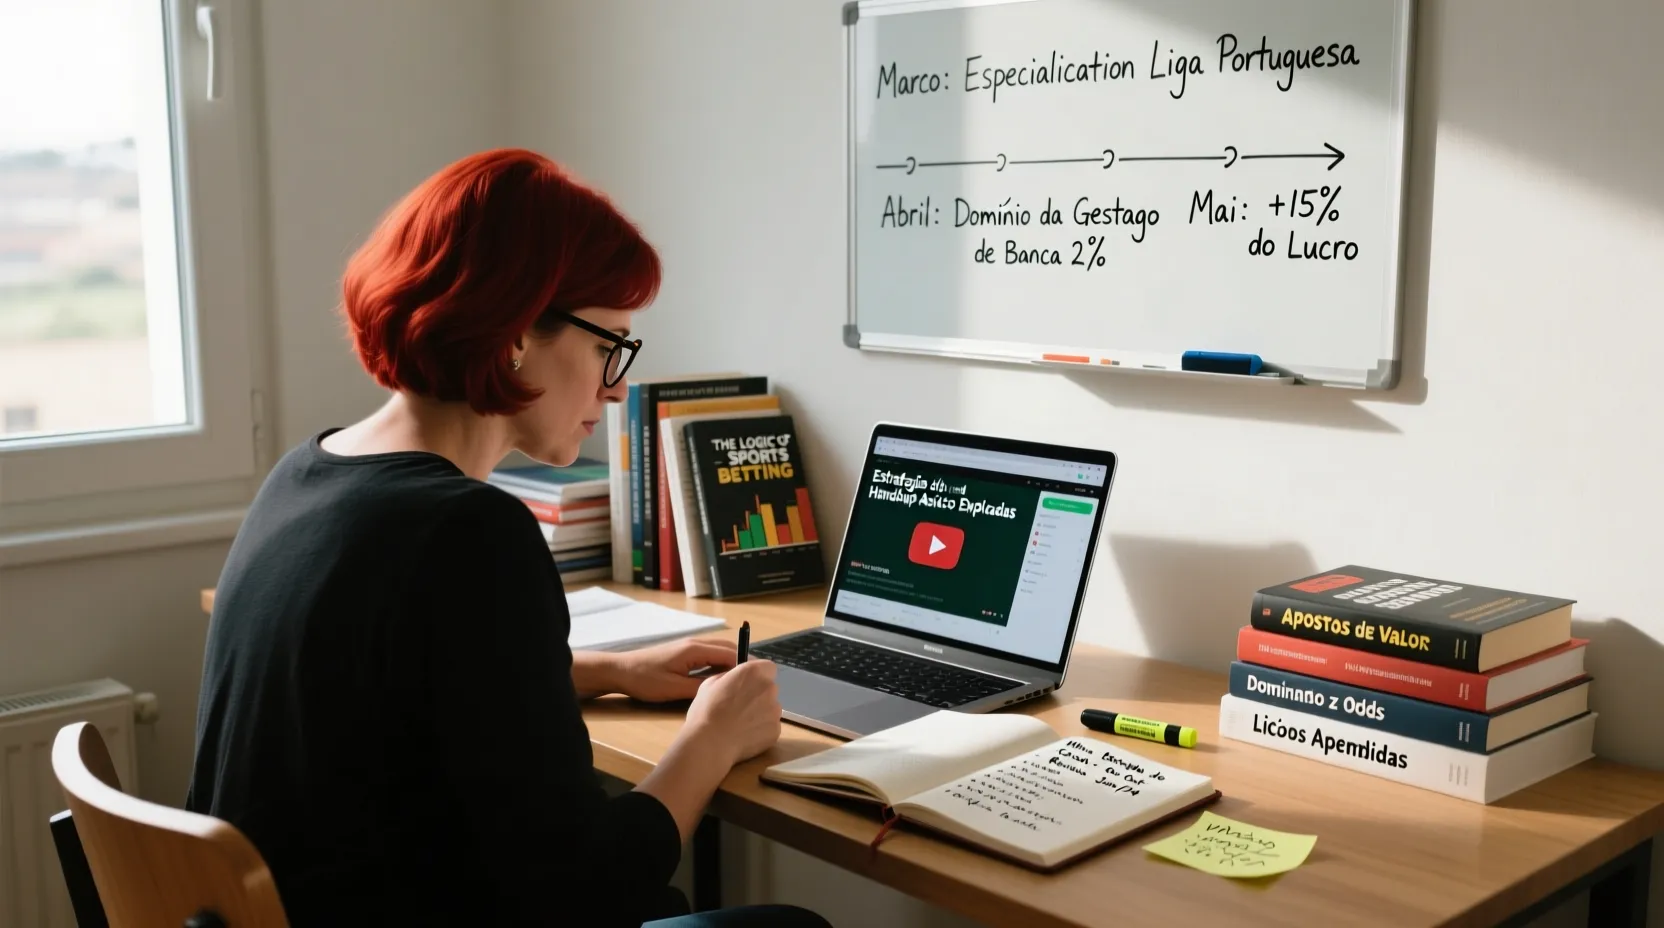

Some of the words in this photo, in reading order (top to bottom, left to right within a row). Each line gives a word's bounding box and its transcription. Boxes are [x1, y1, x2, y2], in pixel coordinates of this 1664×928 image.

[876, 61, 949, 100] Marco:
[964, 50, 1135, 103] Especialication
[1150, 39, 1205, 99] Liga
[1216, 33, 1360, 92] Portuguesa
[881, 195, 940, 228] Abril:
[954, 196, 1031, 228] Domínio
[1039, 196, 1064, 226] da
[1072, 196, 1160, 244] Gestago
[1189, 188, 1248, 225] Mai:
[1268, 185, 1342, 226] +15%
[974, 237, 996, 265] de
[1004, 239, 1062, 265] Banca
[1071, 235, 1106, 271] 2%
[1248, 227, 1276, 257] do
[1287, 229, 1359, 261] Lucro
[710, 438, 738, 451] THE
[739, 435, 776, 450] LOGIC
[727, 447, 790, 466] SPORTS
[717, 462, 794, 484] BETTING
[1343, 696, 1386, 721] Odds
